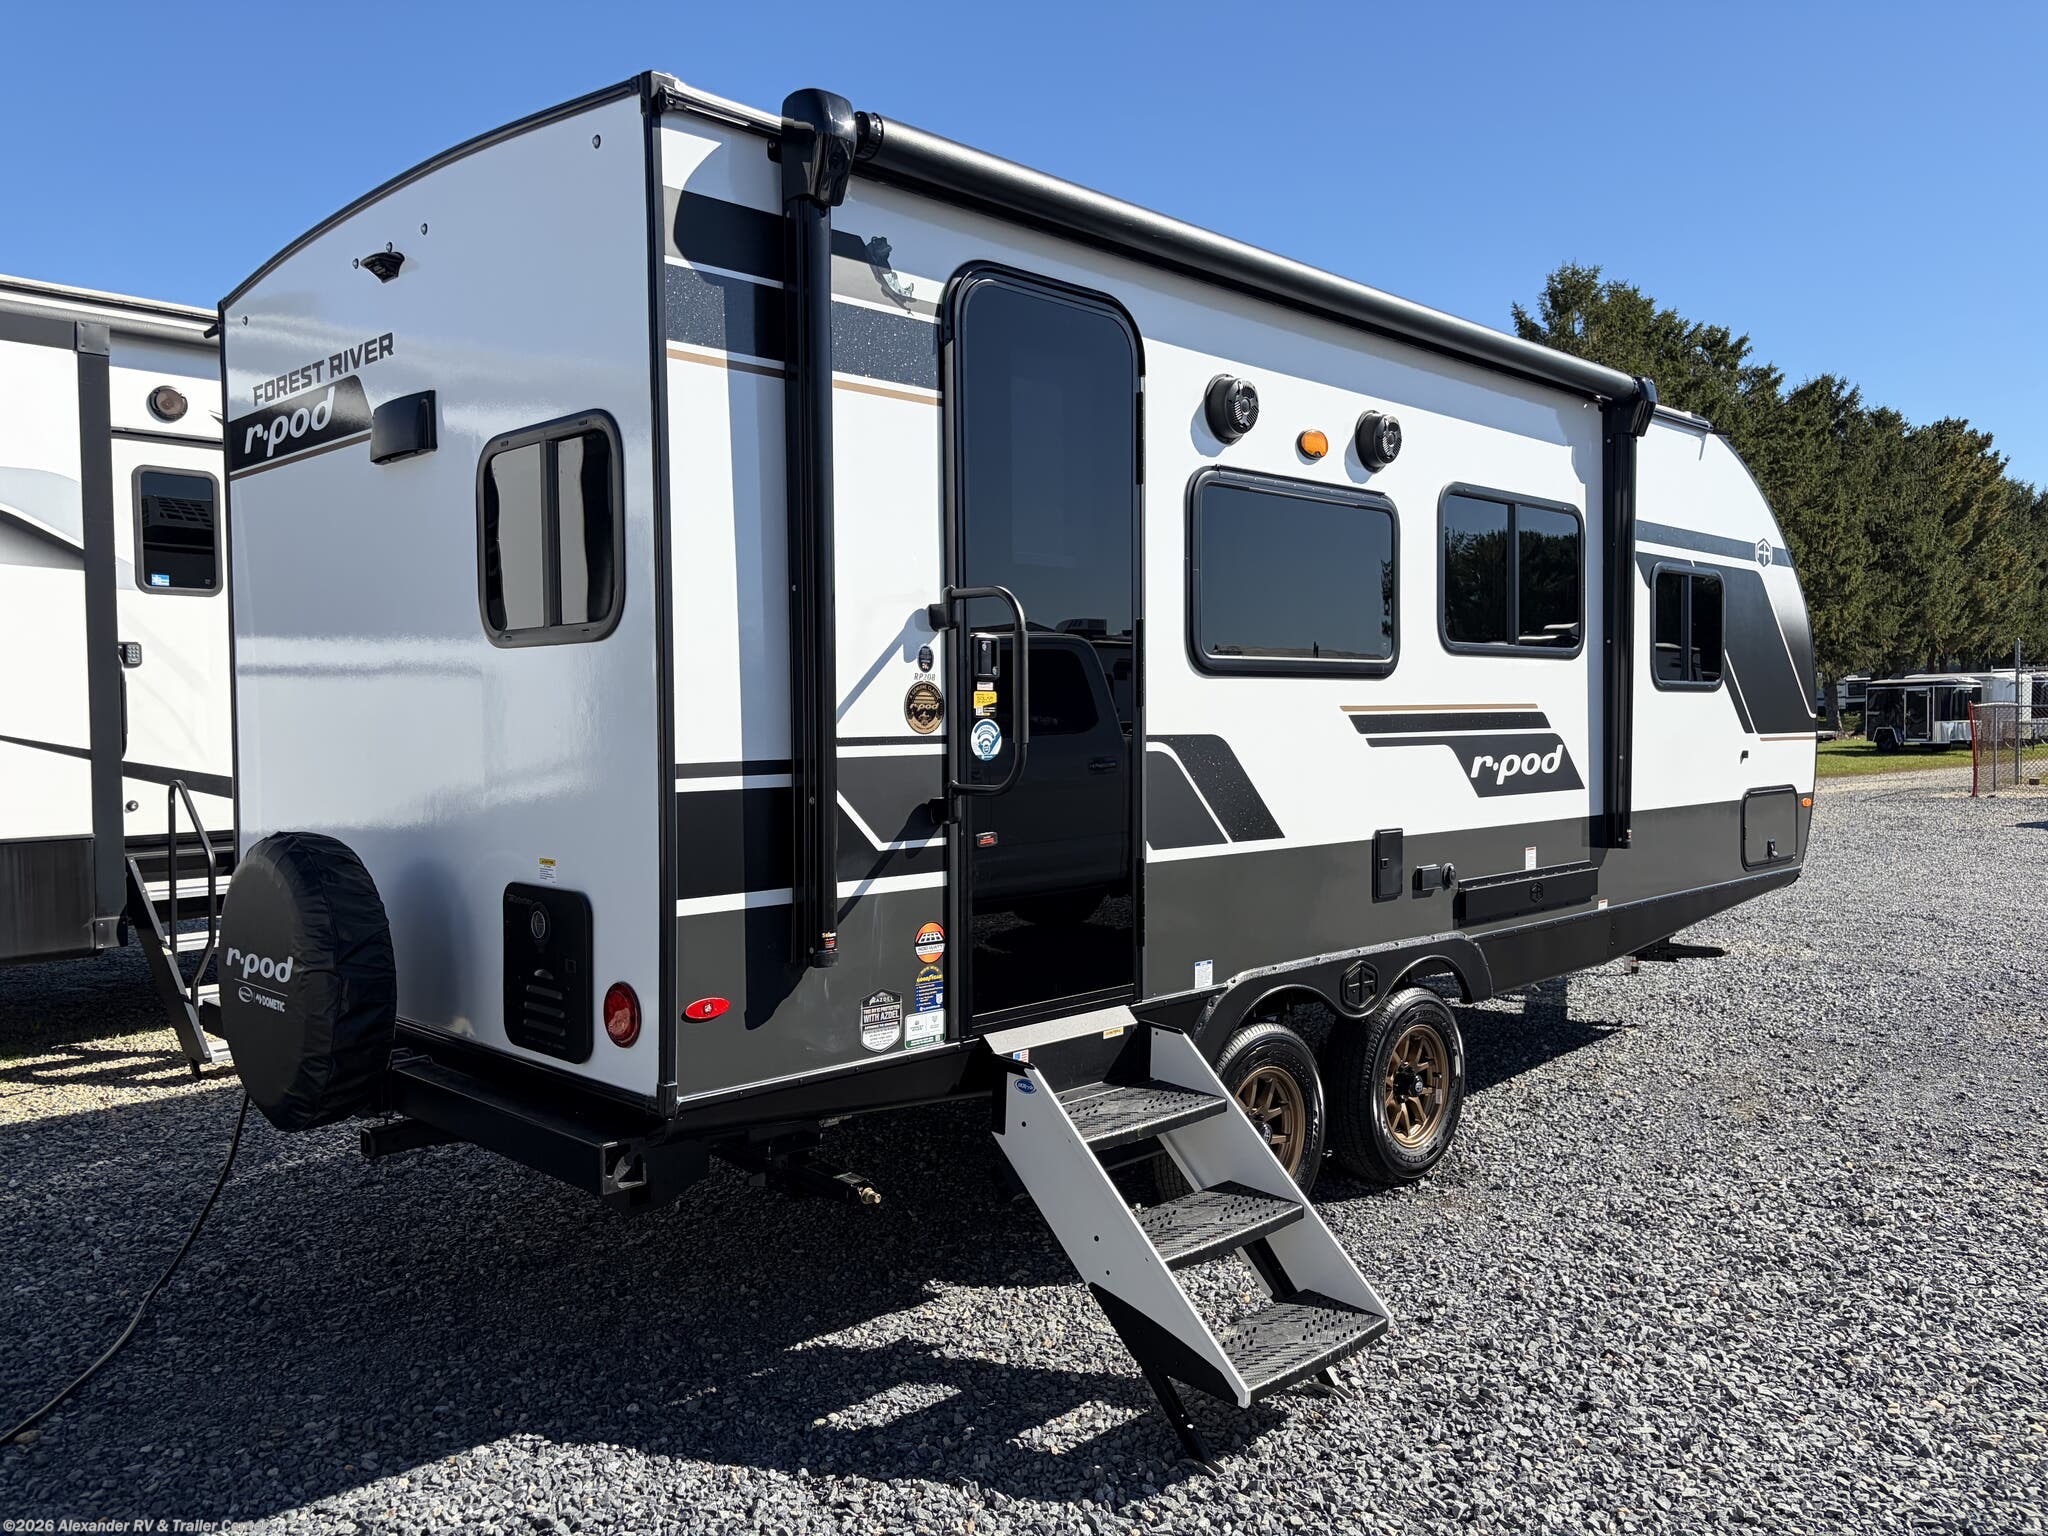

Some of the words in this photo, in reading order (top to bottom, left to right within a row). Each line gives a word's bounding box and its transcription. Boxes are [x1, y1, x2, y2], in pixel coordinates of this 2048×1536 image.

[253, 359, 324, 407] FOREST
[329, 332, 394, 378] RIVER
[863, 1012, 880, 1024] WITH
[880, 1009, 899, 1021] AZDEL
